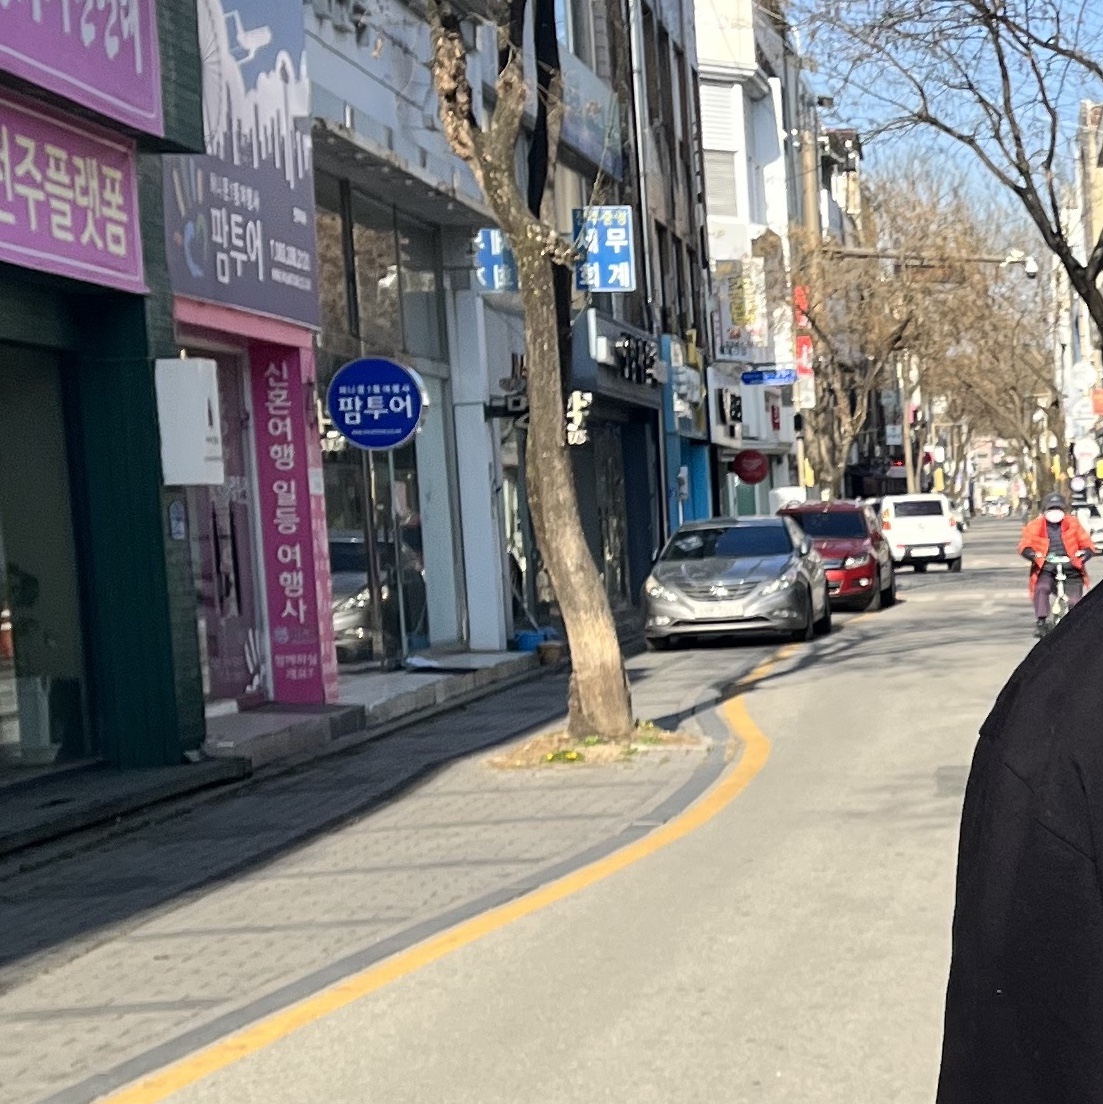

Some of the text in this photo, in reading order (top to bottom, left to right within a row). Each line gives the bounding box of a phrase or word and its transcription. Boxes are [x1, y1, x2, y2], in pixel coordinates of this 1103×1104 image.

[210, 206, 264, 284] 팜투어
[337, 393, 413, 425] 팜투어
[277, 542, 308, 624] 여행사
